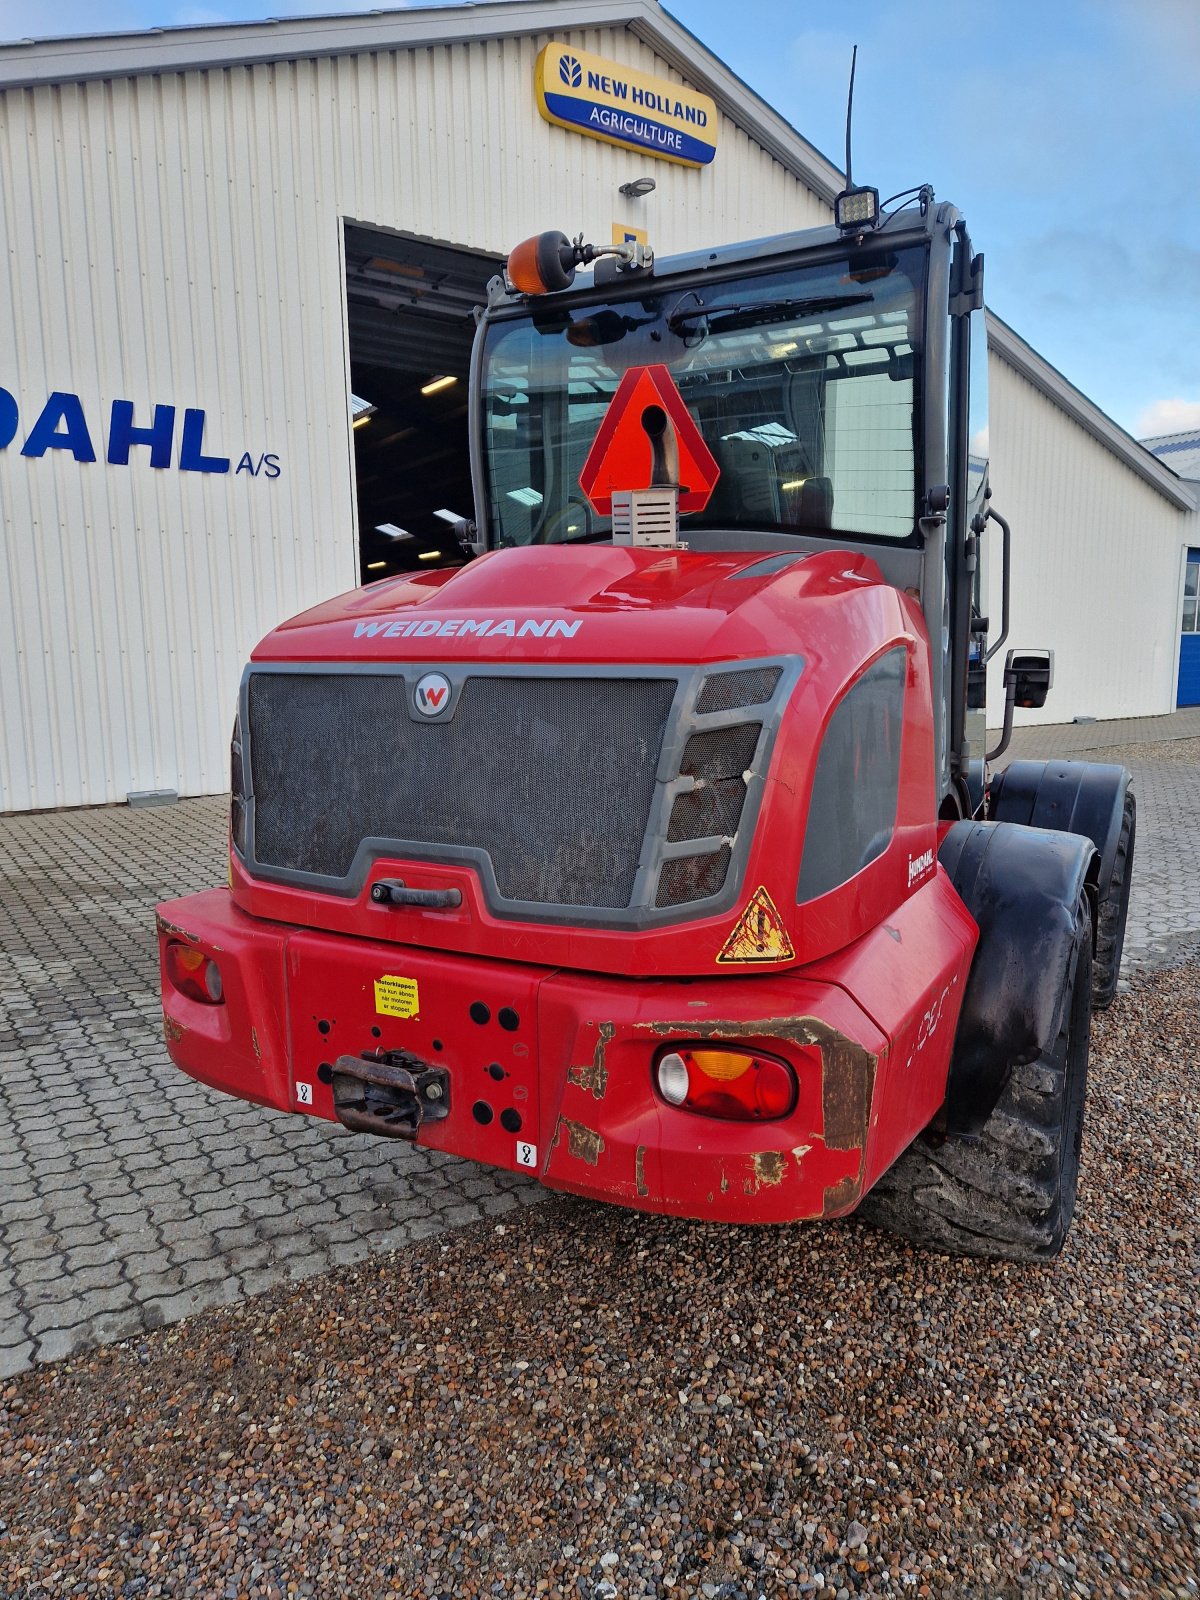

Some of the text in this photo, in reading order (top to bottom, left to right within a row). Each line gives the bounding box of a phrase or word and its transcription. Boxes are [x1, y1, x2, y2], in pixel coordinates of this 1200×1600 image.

[587, 71, 707, 128] NEW HOLLAND
[589, 106, 683, 150] AGRICULTURE
[0, 386, 281, 478] AHL A/S
[353, 619, 584, 638] WEIDEMANN
